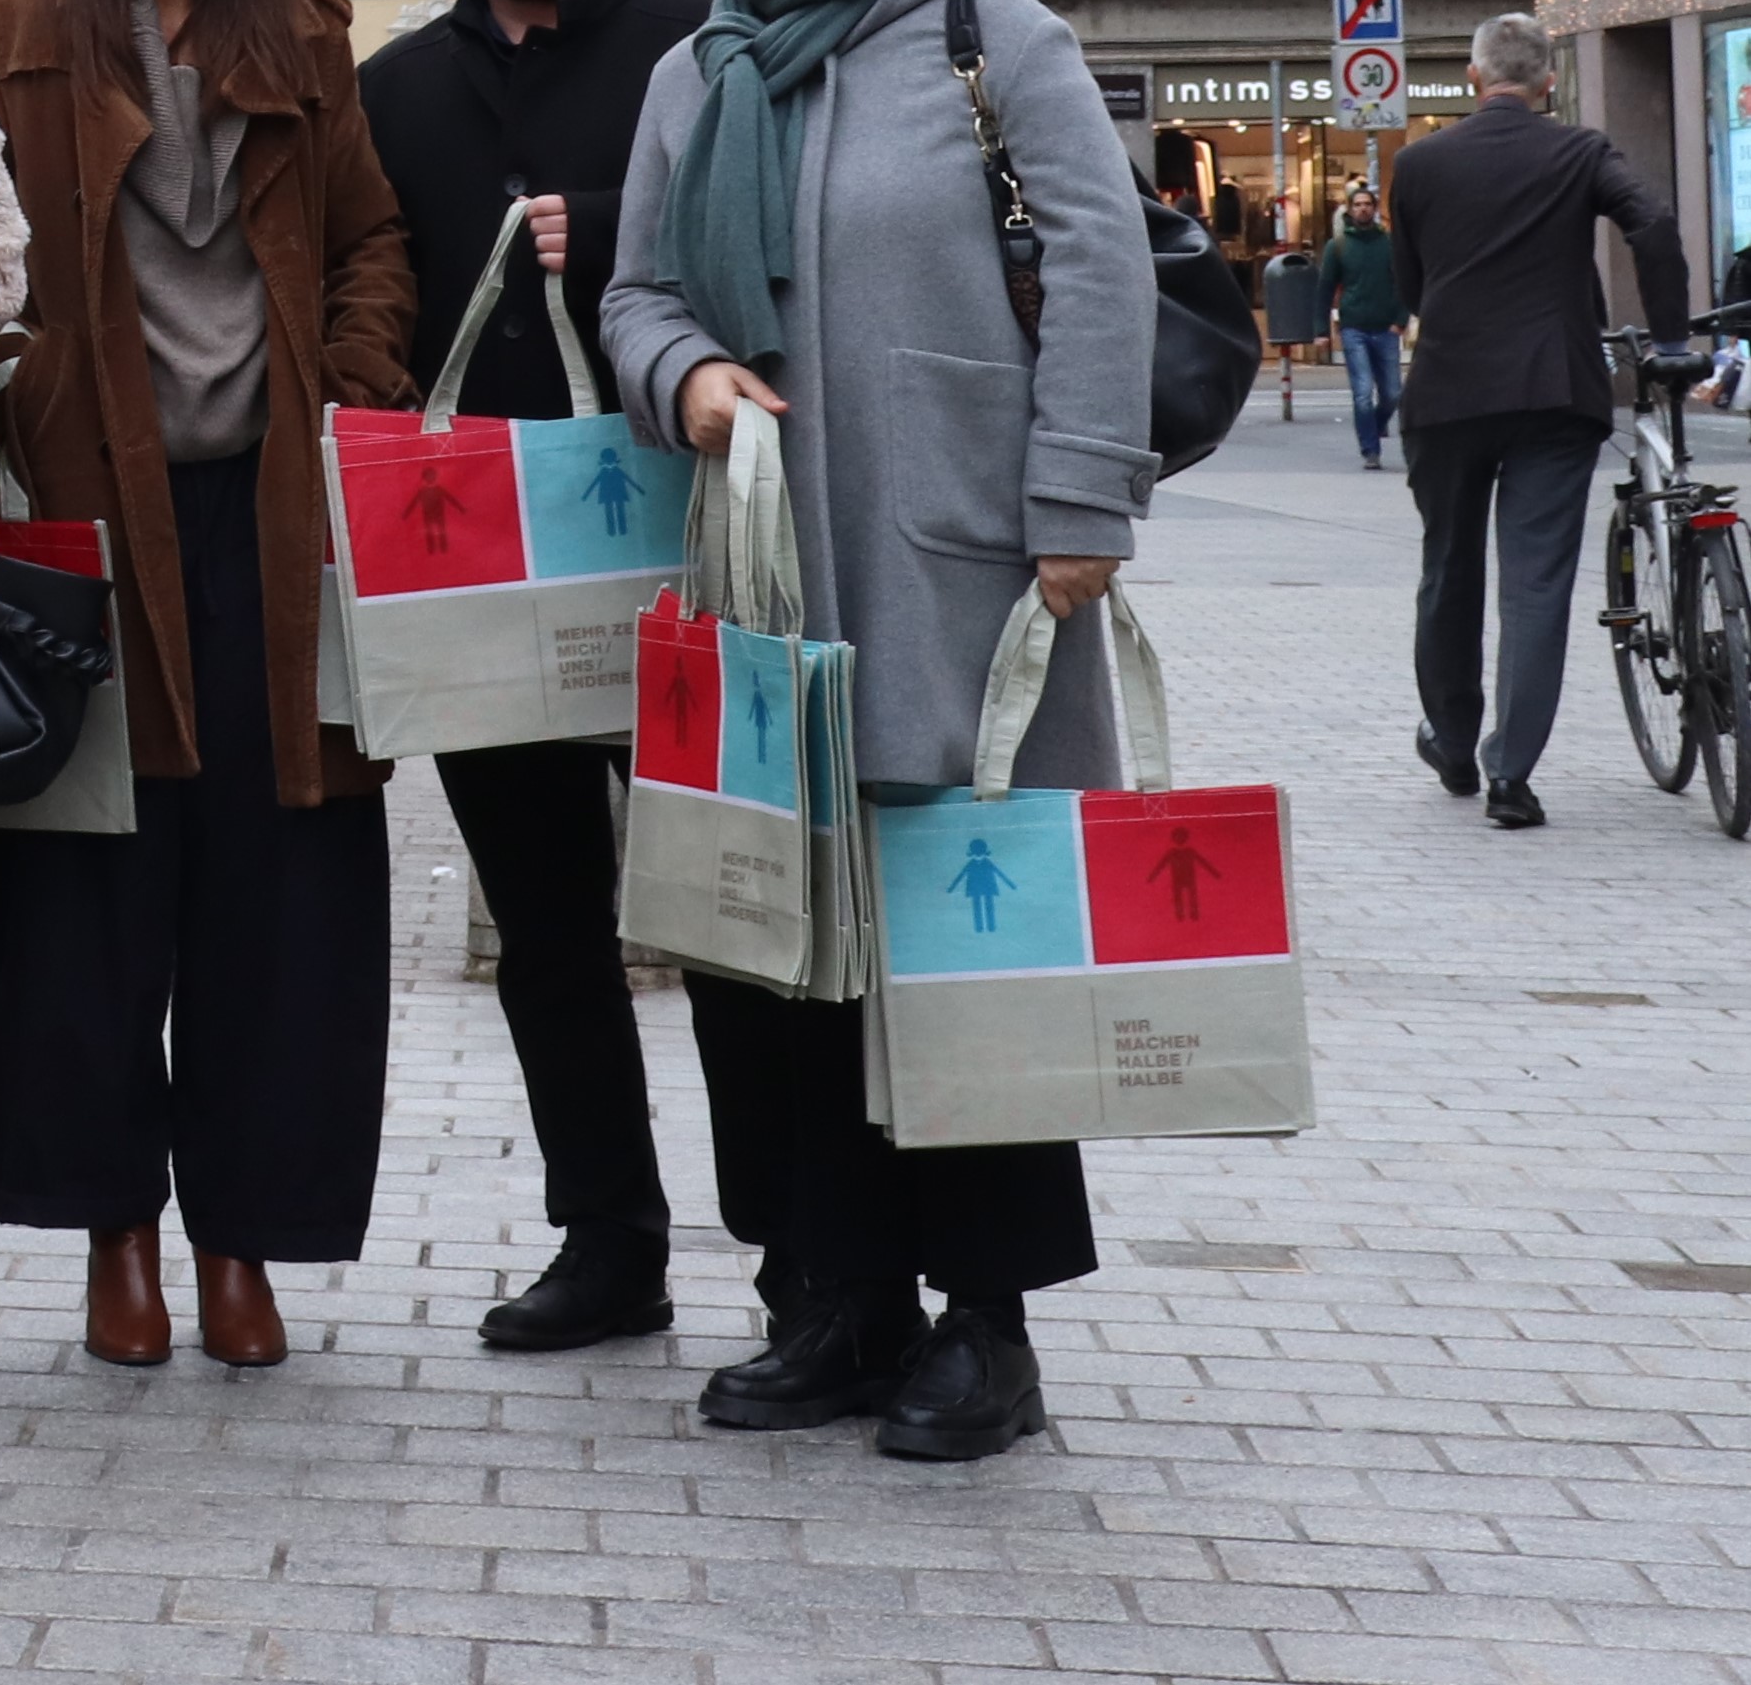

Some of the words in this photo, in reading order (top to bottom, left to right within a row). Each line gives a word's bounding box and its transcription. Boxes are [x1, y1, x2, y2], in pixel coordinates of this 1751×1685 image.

[1359, 63, 1384, 87] 30
[1407, 83, 1464, 98] Italian
[554, 625, 606, 642] MEHR
[611, 621, 635, 636] ZE
[561, 671, 633, 691] ANDERE
[1113, 1019, 1151, 1034] WIR
[1115, 1034, 1201, 1052] MACHEN
[1117, 1053, 1182, 1069] HALBE
[1119, 1071, 1184, 1088] HALBE
